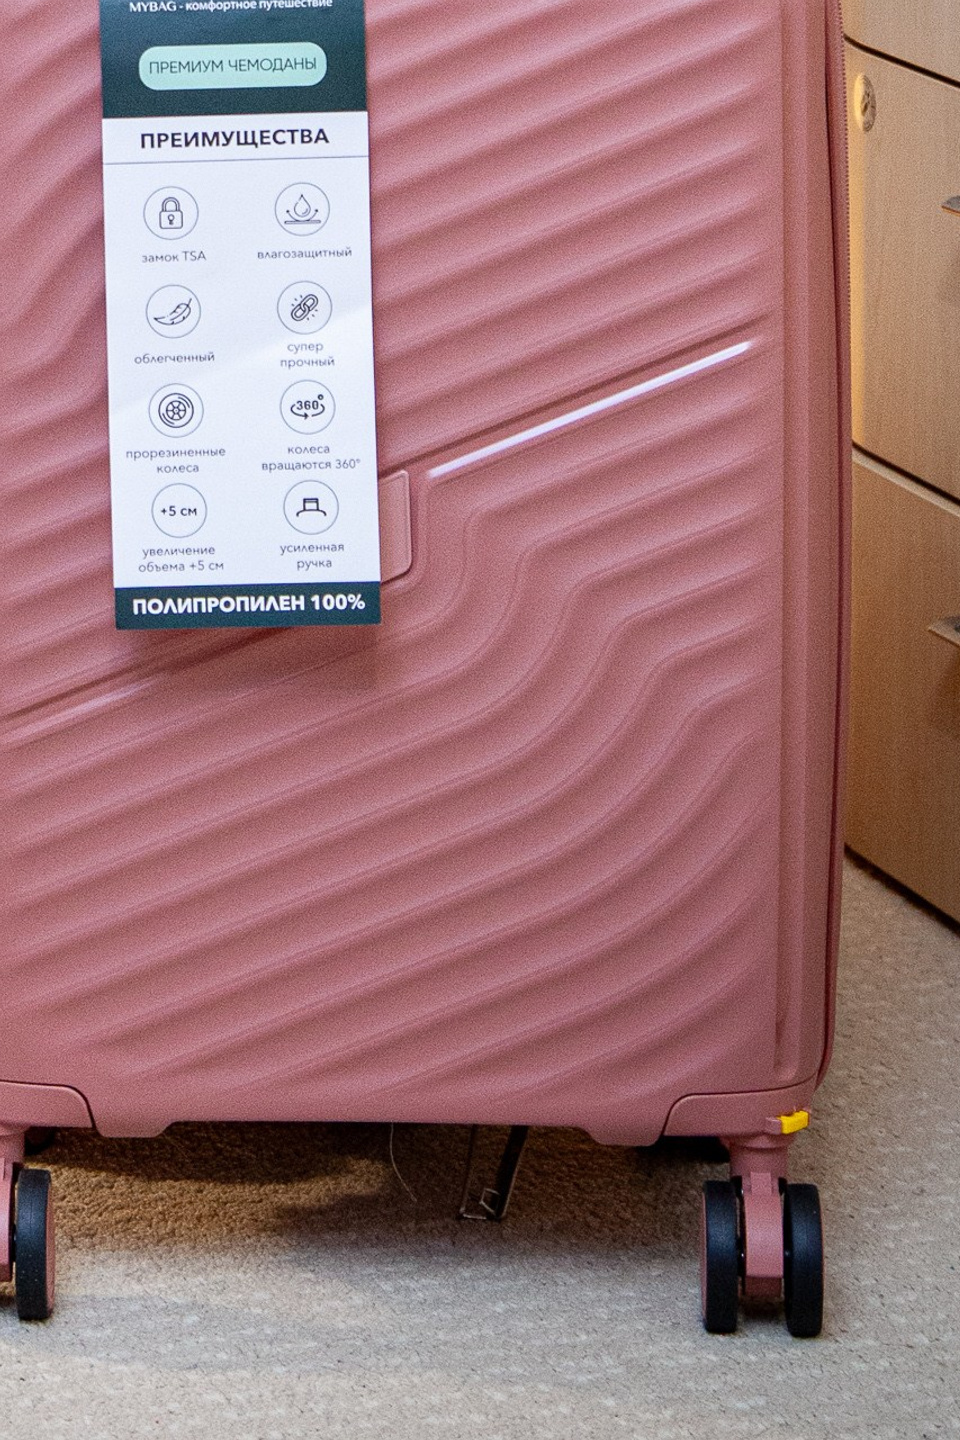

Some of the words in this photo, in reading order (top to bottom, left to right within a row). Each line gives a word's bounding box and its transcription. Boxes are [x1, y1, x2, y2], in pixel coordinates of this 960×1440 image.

[129, 1, 176, 12] MYBAG
[186, 1, 256, 12] комфортное
[150, 61, 224, 74] ПРЕМИУМ
[228, 58, 316, 72] ЧЕМОДАНЫ
[141, 129, 329, 149] ПРЕИМУЩЕСТВА
[142, 253, 179, 263] замок
[182, 251, 207, 260] TSA
[258, 248, 352, 259] влагозащитный
[287, 342, 323, 352] супер
[134, 352, 214, 365] облегченный
[280, 357, 335, 369] прочный
[126, 447, 226, 459] прорезиненные
[288, 444, 330, 454] колеса
[157, 464, 199, 473] колеса
[262, 460, 331, 471] вращаются
[335, 458, 361, 469] 360°
[161, 506, 177, 516] +5
[180, 507, 197, 516] см
[142, 546, 215, 558] увеличение
[280, 543, 344, 554] усиленная
[139, 561, 185, 572] объема
[189, 561, 207, 571] +5
[209, 561, 224, 570] см
[297, 559, 332, 571] ручка
[133, 596, 305, 615] ПОЛИПРОПИЛЕН
[310, 594, 365, 611] 100%
